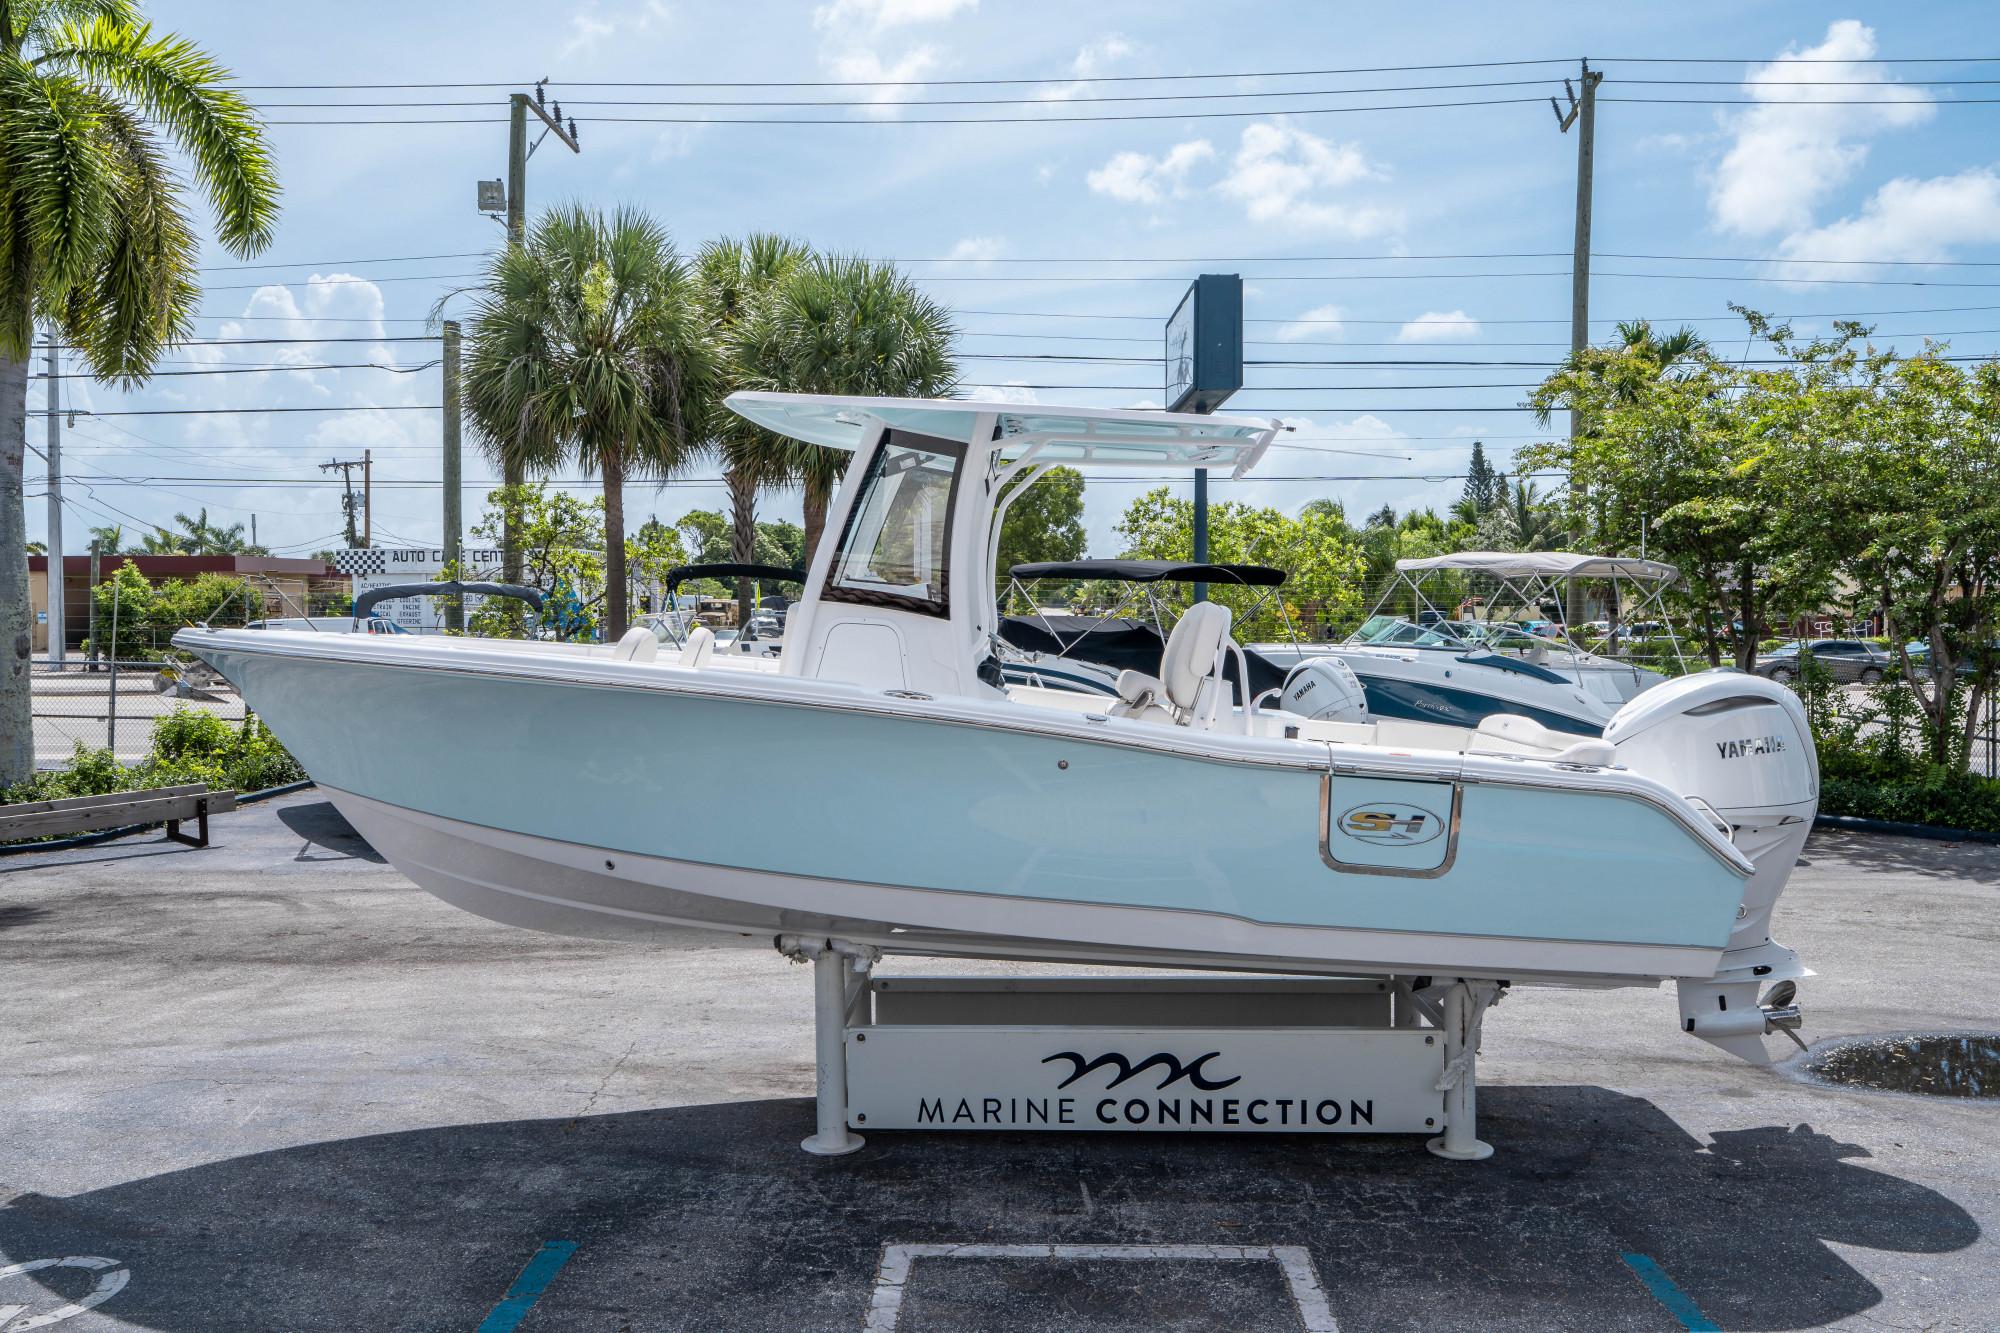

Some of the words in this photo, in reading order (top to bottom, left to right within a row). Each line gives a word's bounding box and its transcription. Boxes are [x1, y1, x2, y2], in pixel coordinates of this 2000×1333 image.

[392, 550, 425, 562] AUTO
[432, 550, 466, 562] CE
[473, 550, 504, 562] CENT
[1293, 680, 1317, 701] YAMAHA
[1716, 735, 1787, 760] YAMAHA
[917, 1098, 1076, 1124] MARINE
[1095, 1099, 1374, 1126] CONNECTION
